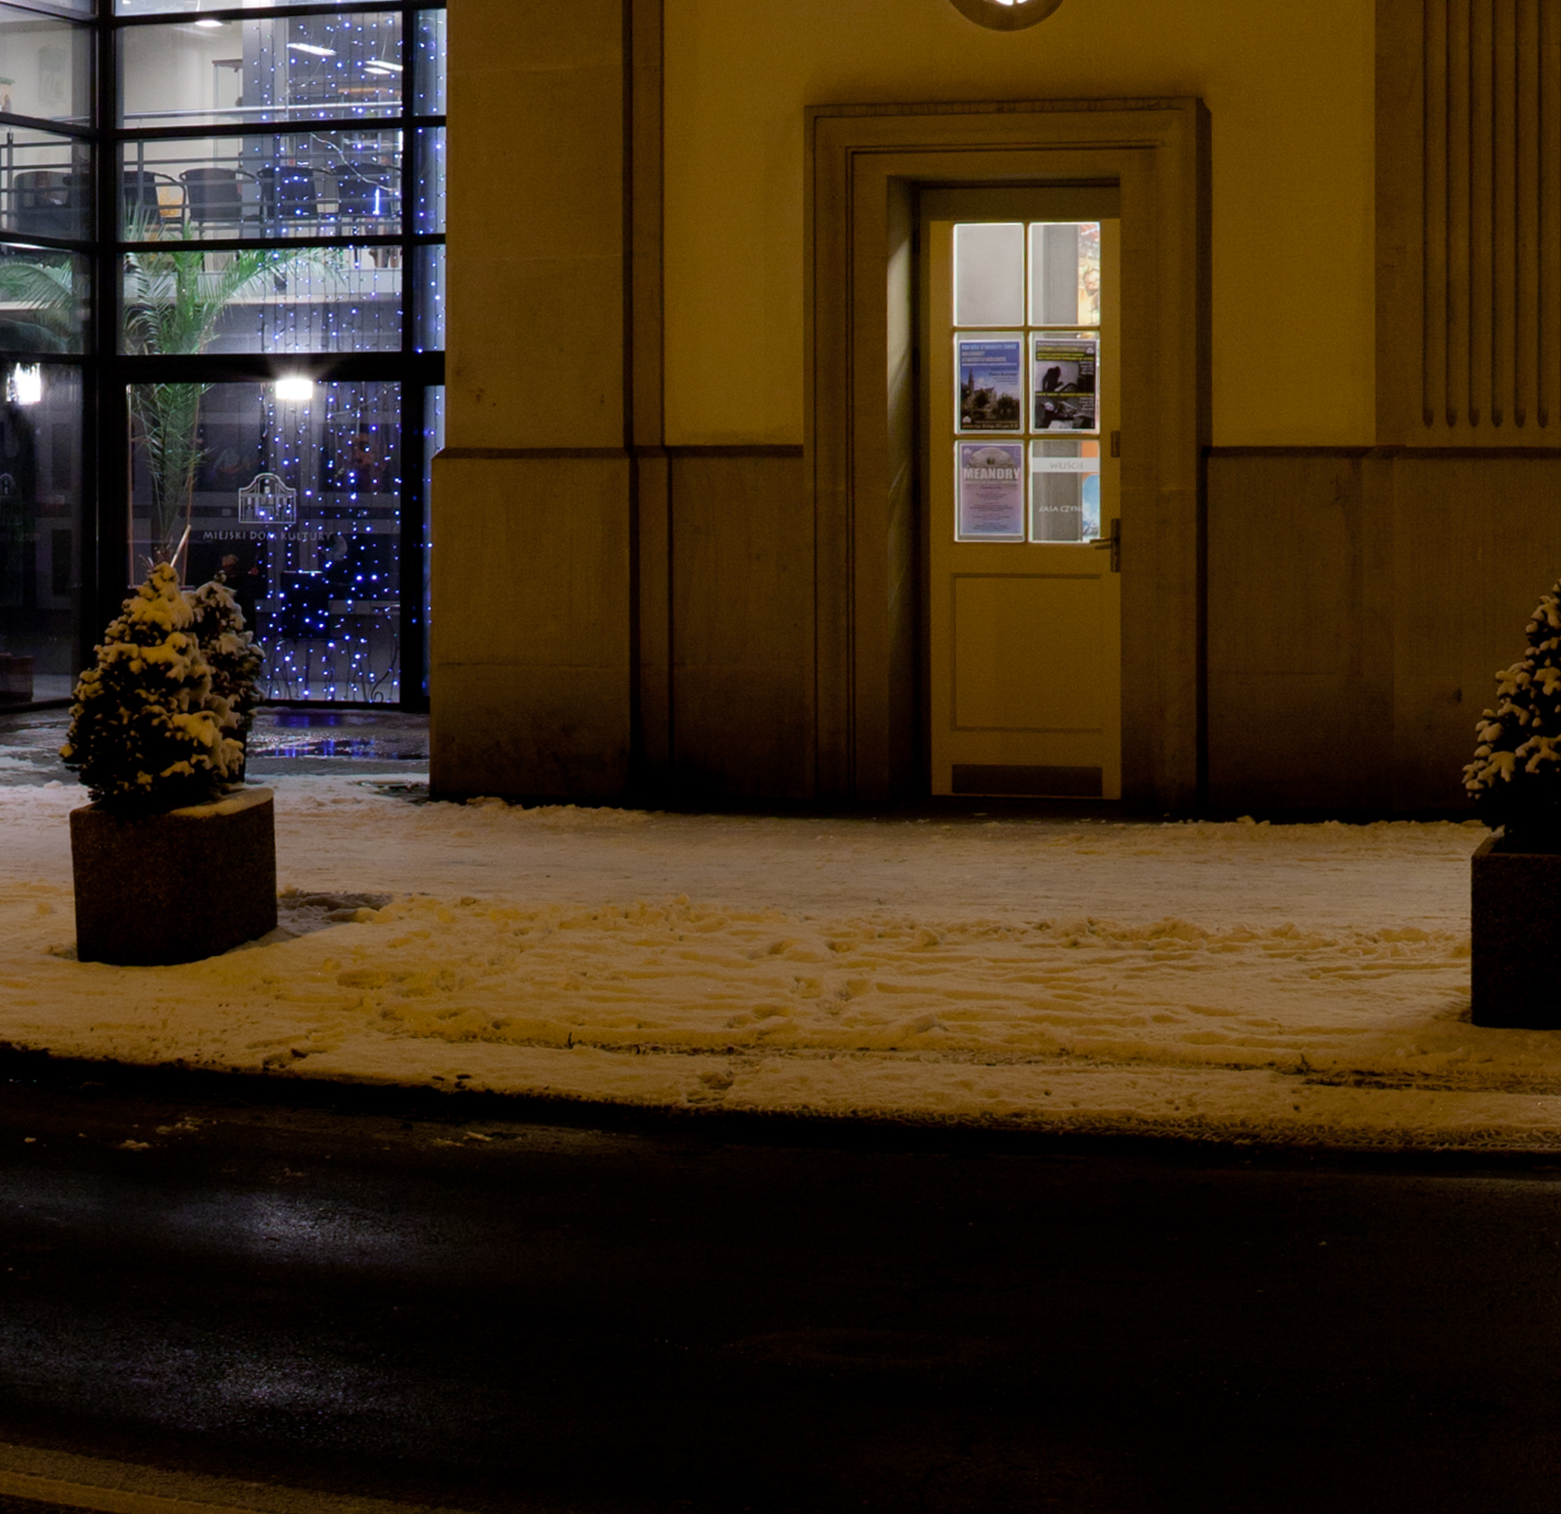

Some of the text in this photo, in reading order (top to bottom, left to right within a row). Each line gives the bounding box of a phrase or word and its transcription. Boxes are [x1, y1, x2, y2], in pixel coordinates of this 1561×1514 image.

[1049, 460, 1084, 470] WEJŚCIE
[963, 467, 1021, 480] MEANDRY
[203, 530, 246, 541] MIEJSKI
[280, 530, 332, 542] KULTURY
